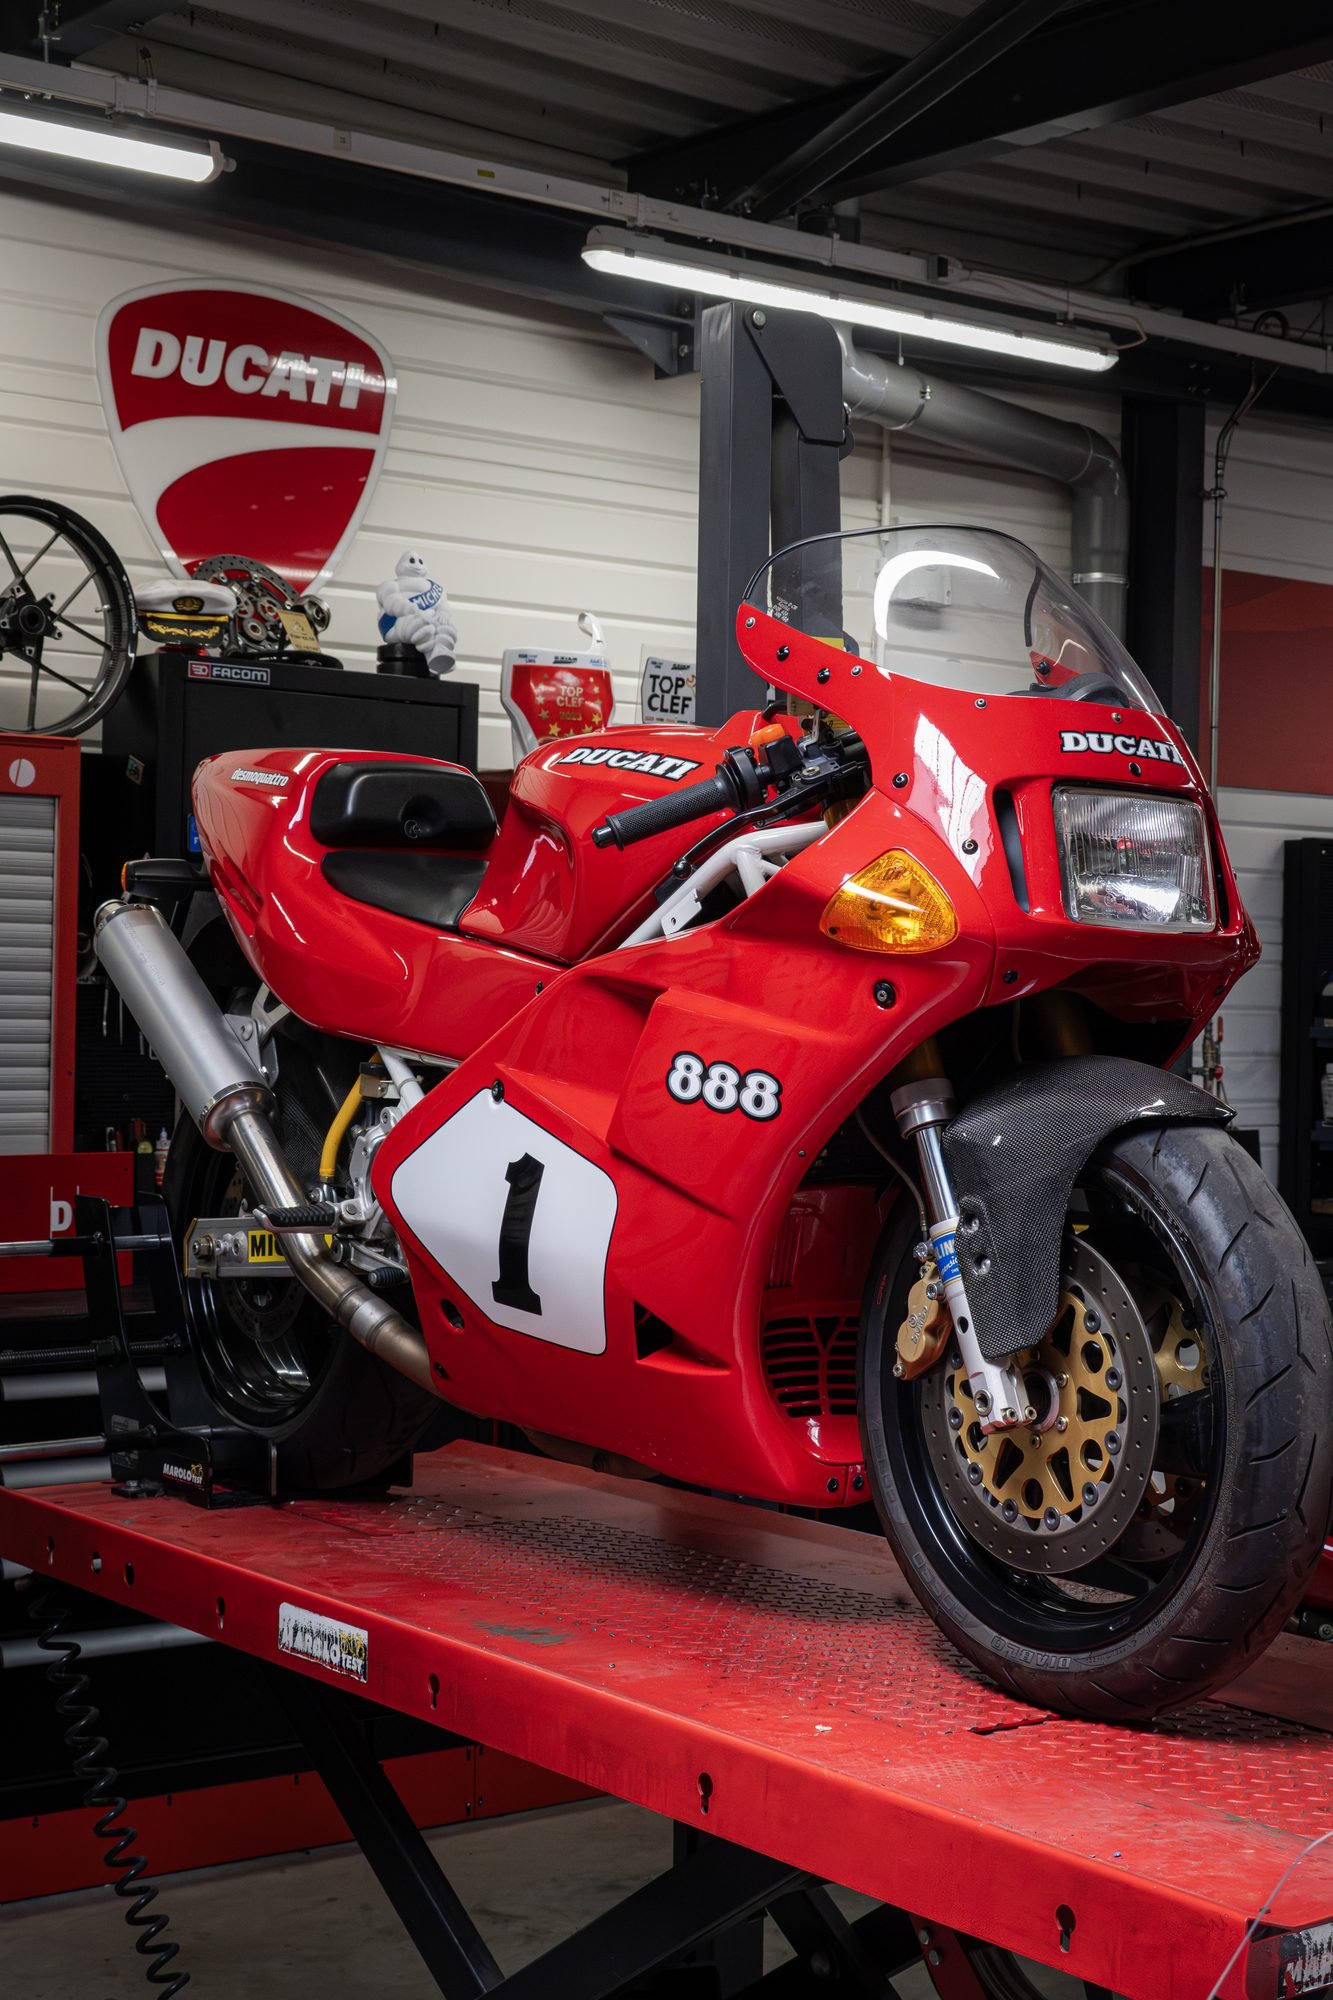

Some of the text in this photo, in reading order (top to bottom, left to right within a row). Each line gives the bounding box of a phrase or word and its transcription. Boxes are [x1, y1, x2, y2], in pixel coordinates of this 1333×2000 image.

[130, 326, 366, 410] DUCATI
[411, 583, 442, 608] MICHE
[211, 666, 267, 682] FACOM
[648, 673, 686, 695] TOP
[556, 695, 584, 708] CLEF
[559, 685, 584, 696] TOP
[646, 692, 693, 715] CLEF
[1060, 731, 1185, 766] DUCATI
[558, 747, 702, 780] DUCATI
[231, 768, 289, 787] desmoquattro
[667, 1052, 781, 1119] 888
[492, 1152, 545, 1316] 1
[163, 1463, 192, 1481] MAROLO
[341, 1652, 364, 1674] TEST
[990, 1634, 1073, 1670] DIABLO
